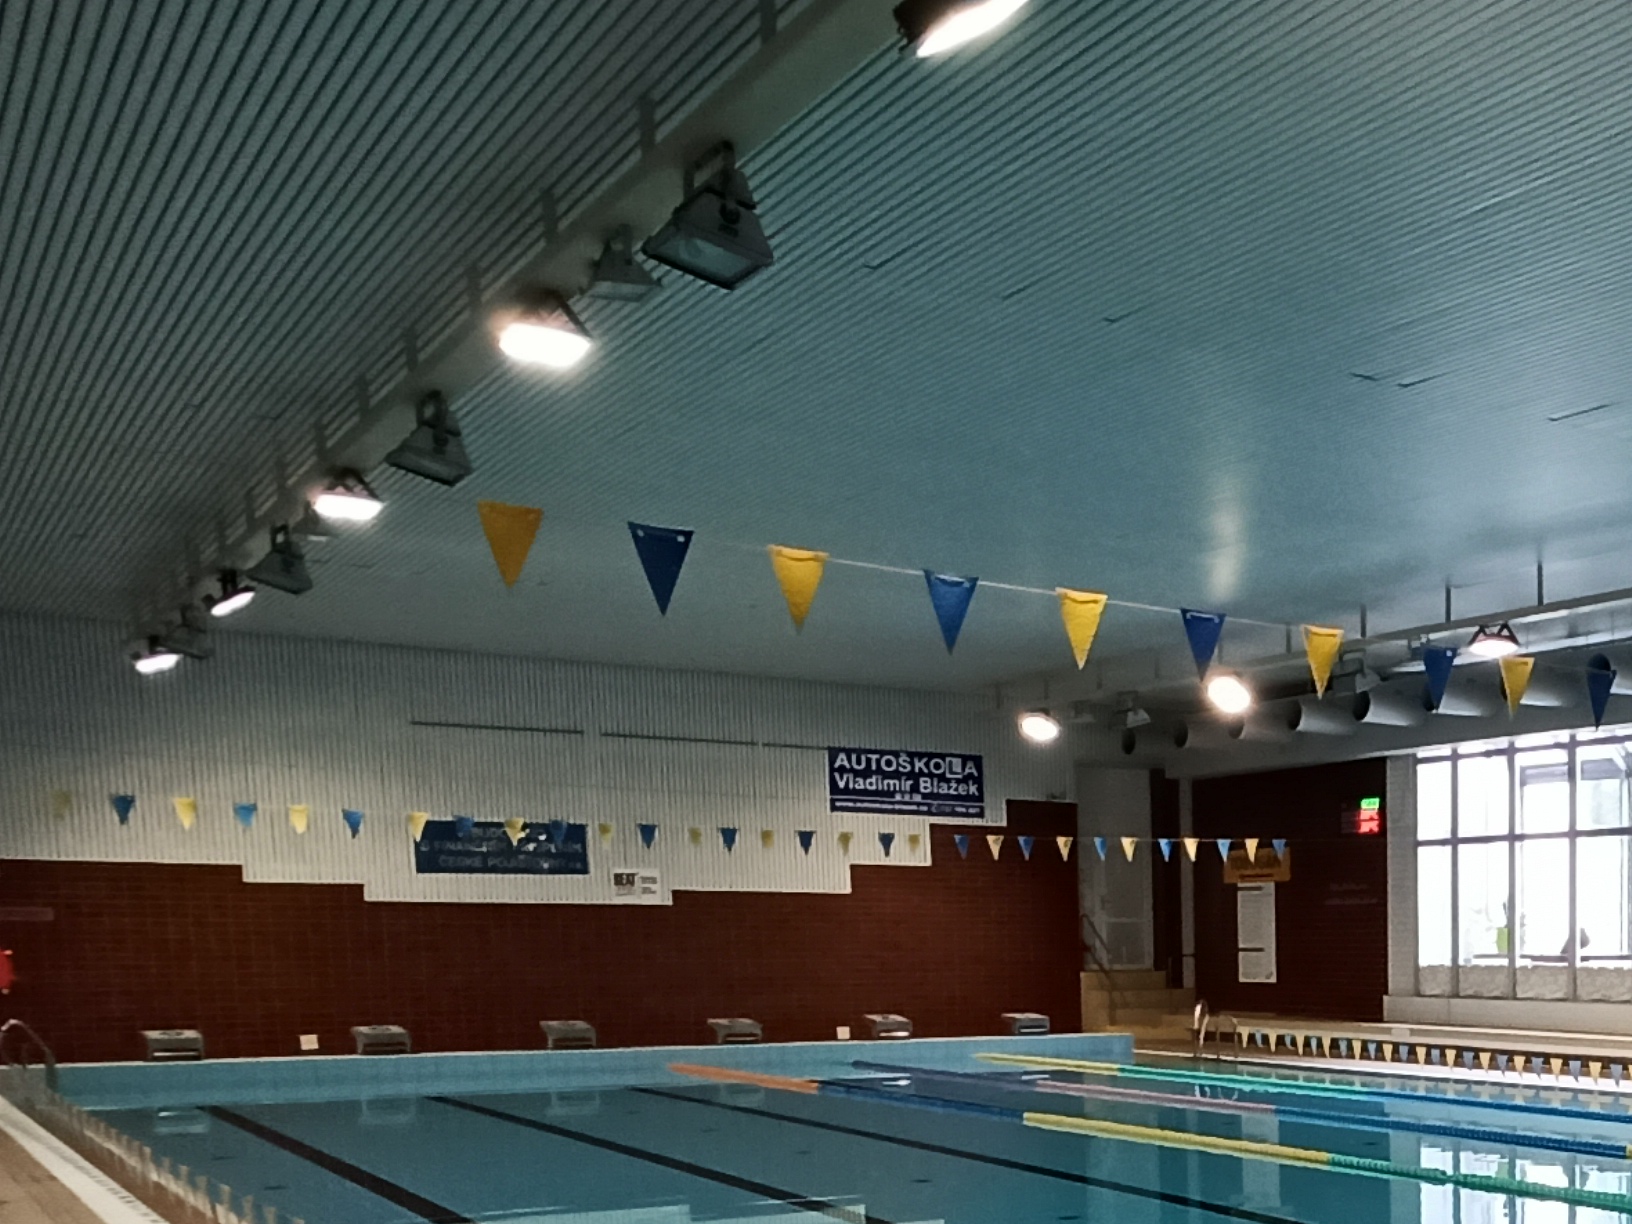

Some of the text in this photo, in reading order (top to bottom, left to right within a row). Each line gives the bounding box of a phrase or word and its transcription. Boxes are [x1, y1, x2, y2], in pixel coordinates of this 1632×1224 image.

[834, 752, 979, 778] AUTOŠKOLA
[834, 771, 979, 796] Vladimír Blažek
